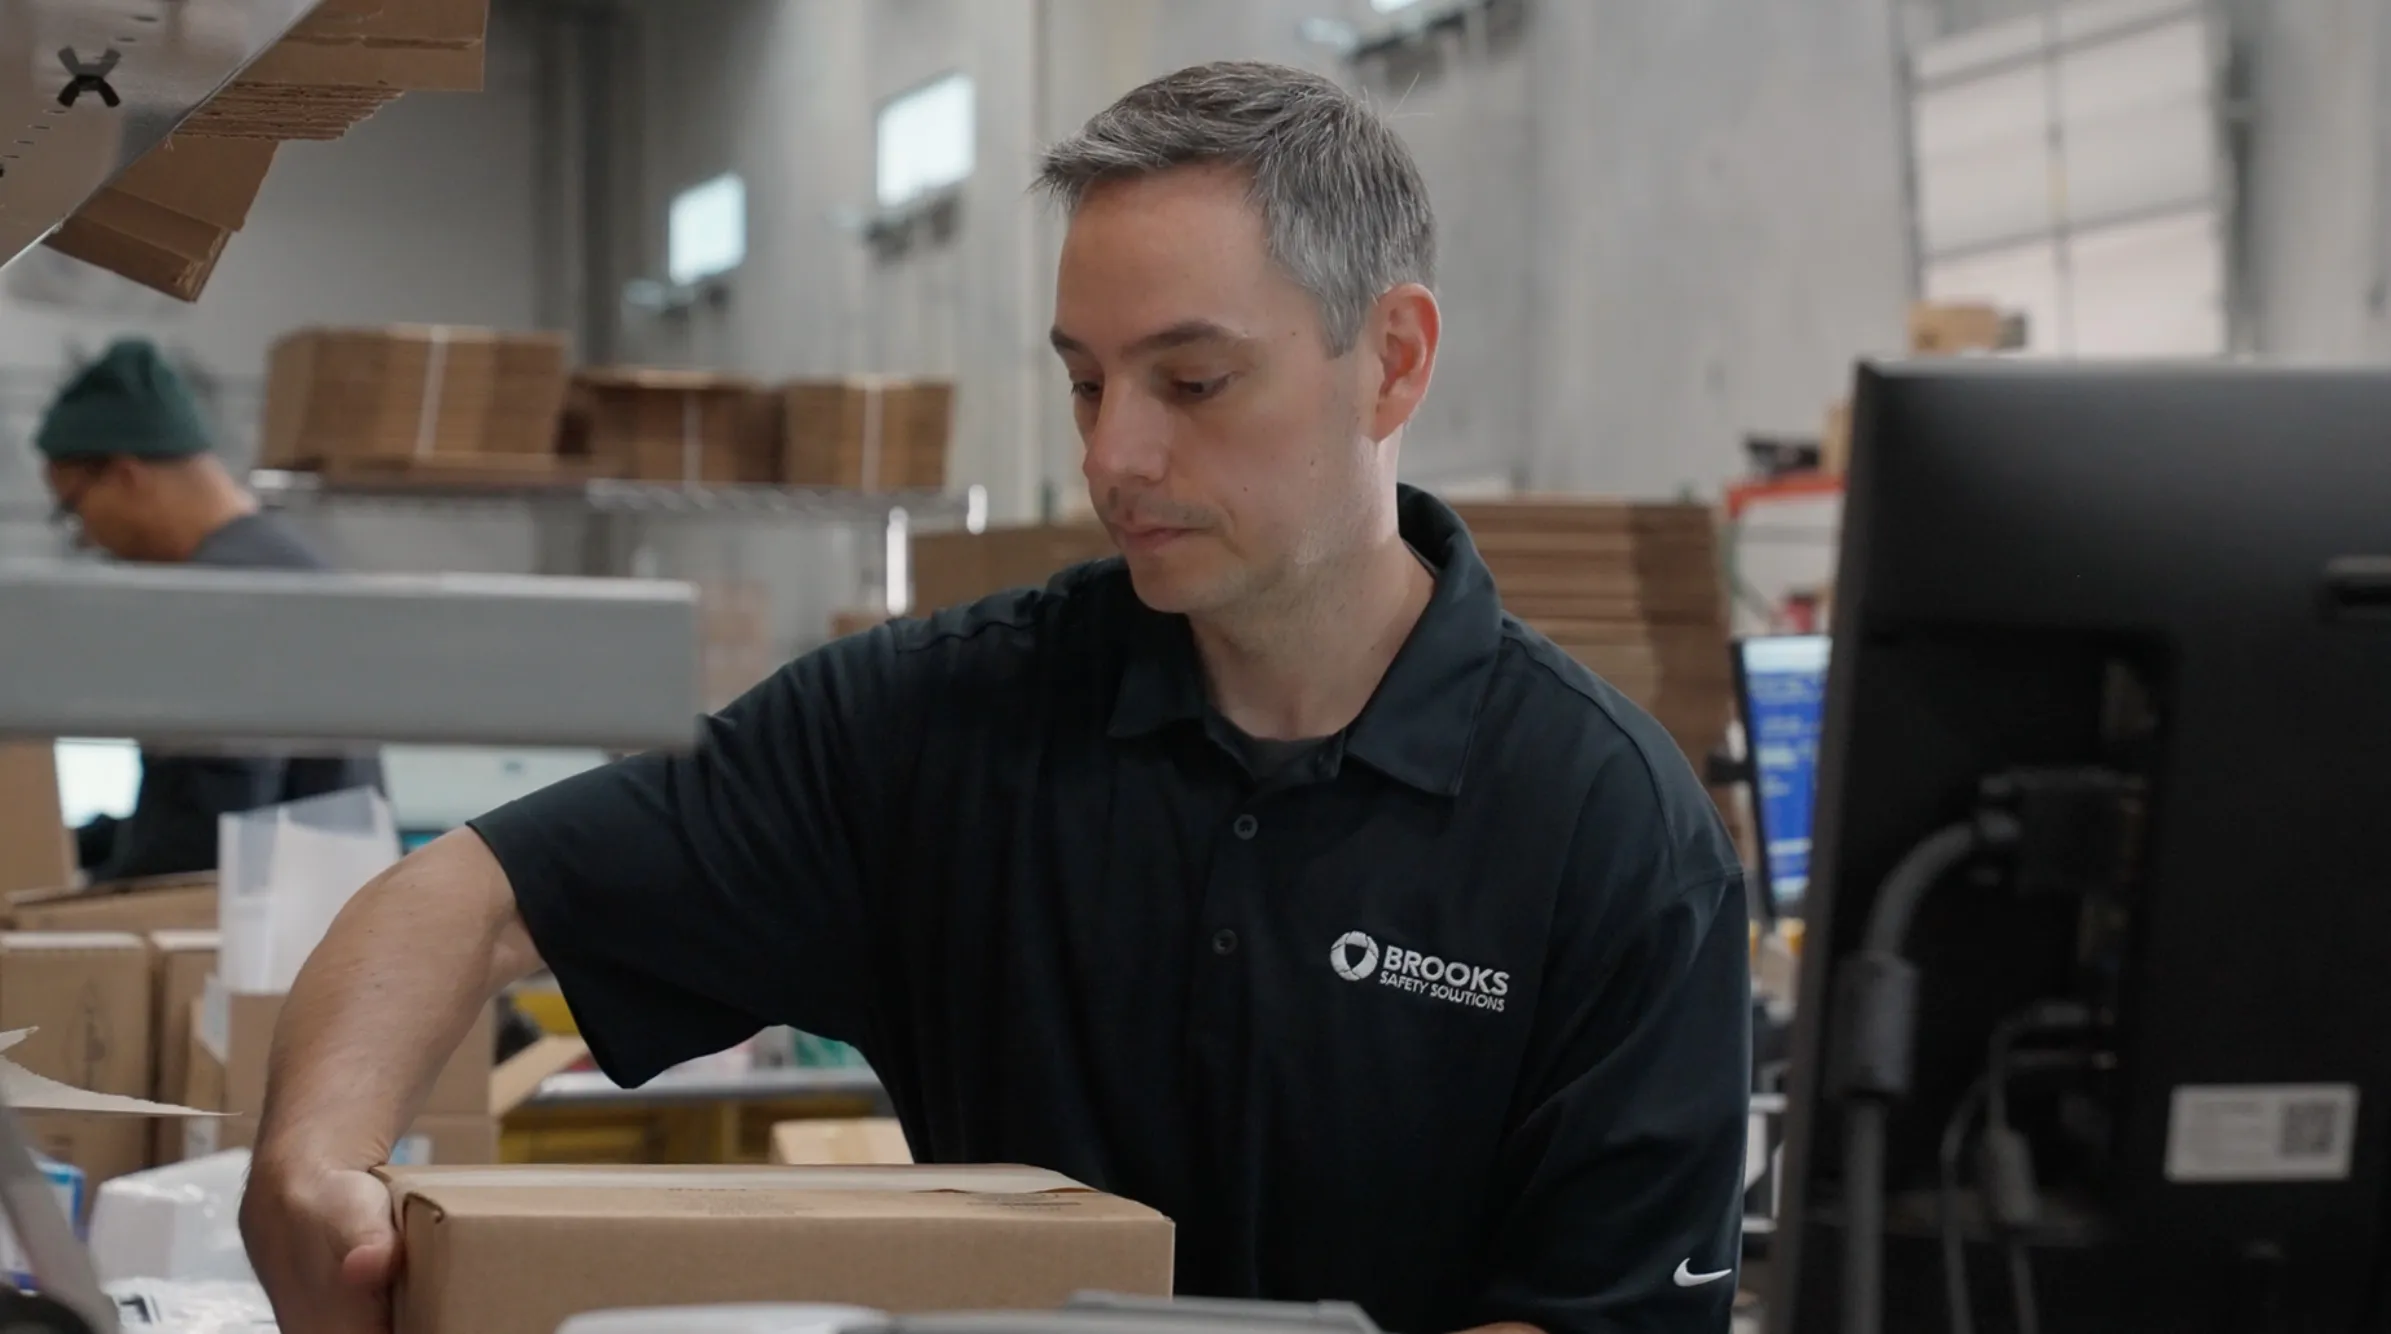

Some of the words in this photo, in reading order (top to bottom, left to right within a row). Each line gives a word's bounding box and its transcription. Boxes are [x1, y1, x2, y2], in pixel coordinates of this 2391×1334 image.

[1379, 971, 1429, 994] SAFETY
[1430, 983, 1505, 1012] SOLUTIONS
[1383, 945, 1510, 996] BROOKS
